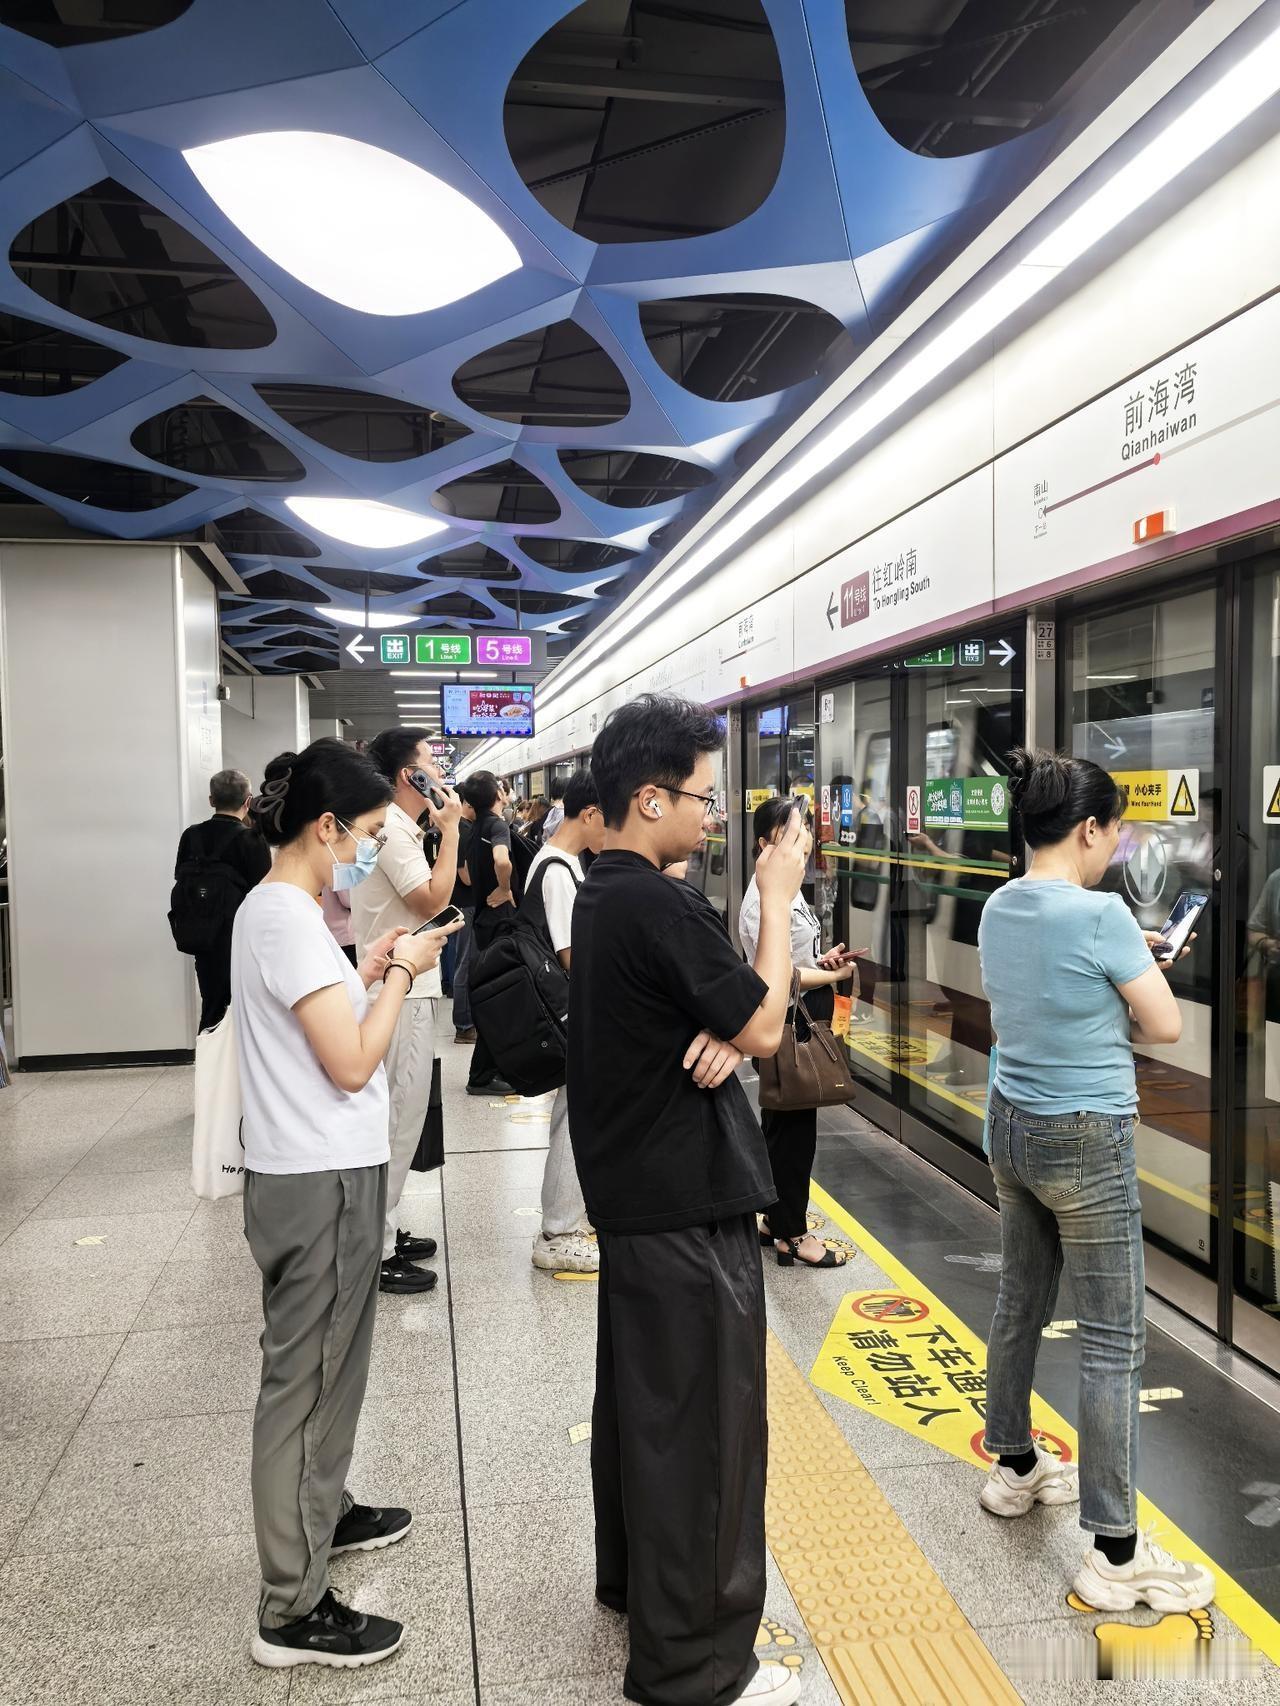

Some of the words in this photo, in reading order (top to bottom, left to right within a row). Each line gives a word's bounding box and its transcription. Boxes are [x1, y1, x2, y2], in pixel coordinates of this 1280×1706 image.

[1124, 363, 1197, 437] 前海湾
[1121, 413, 1197, 461] Qianhaiwan
[872, 548, 917, 594] 往红岭南
[873, 598, 881, 611] To
[882, 587, 909, 608] Hongling
[910, 576, 930, 595] South
[440, 643, 462, 655] 号线
[501, 644, 523, 655] 号线
[1039, 627, 1053, 638] 27
[1135, 784, 1162, 796] 小心夹手
[832, 1355, 855, 1377] Keep
[850, 1379, 882, 1406] Clear!
[847, 1329, 962, 1427] 请勿站人
